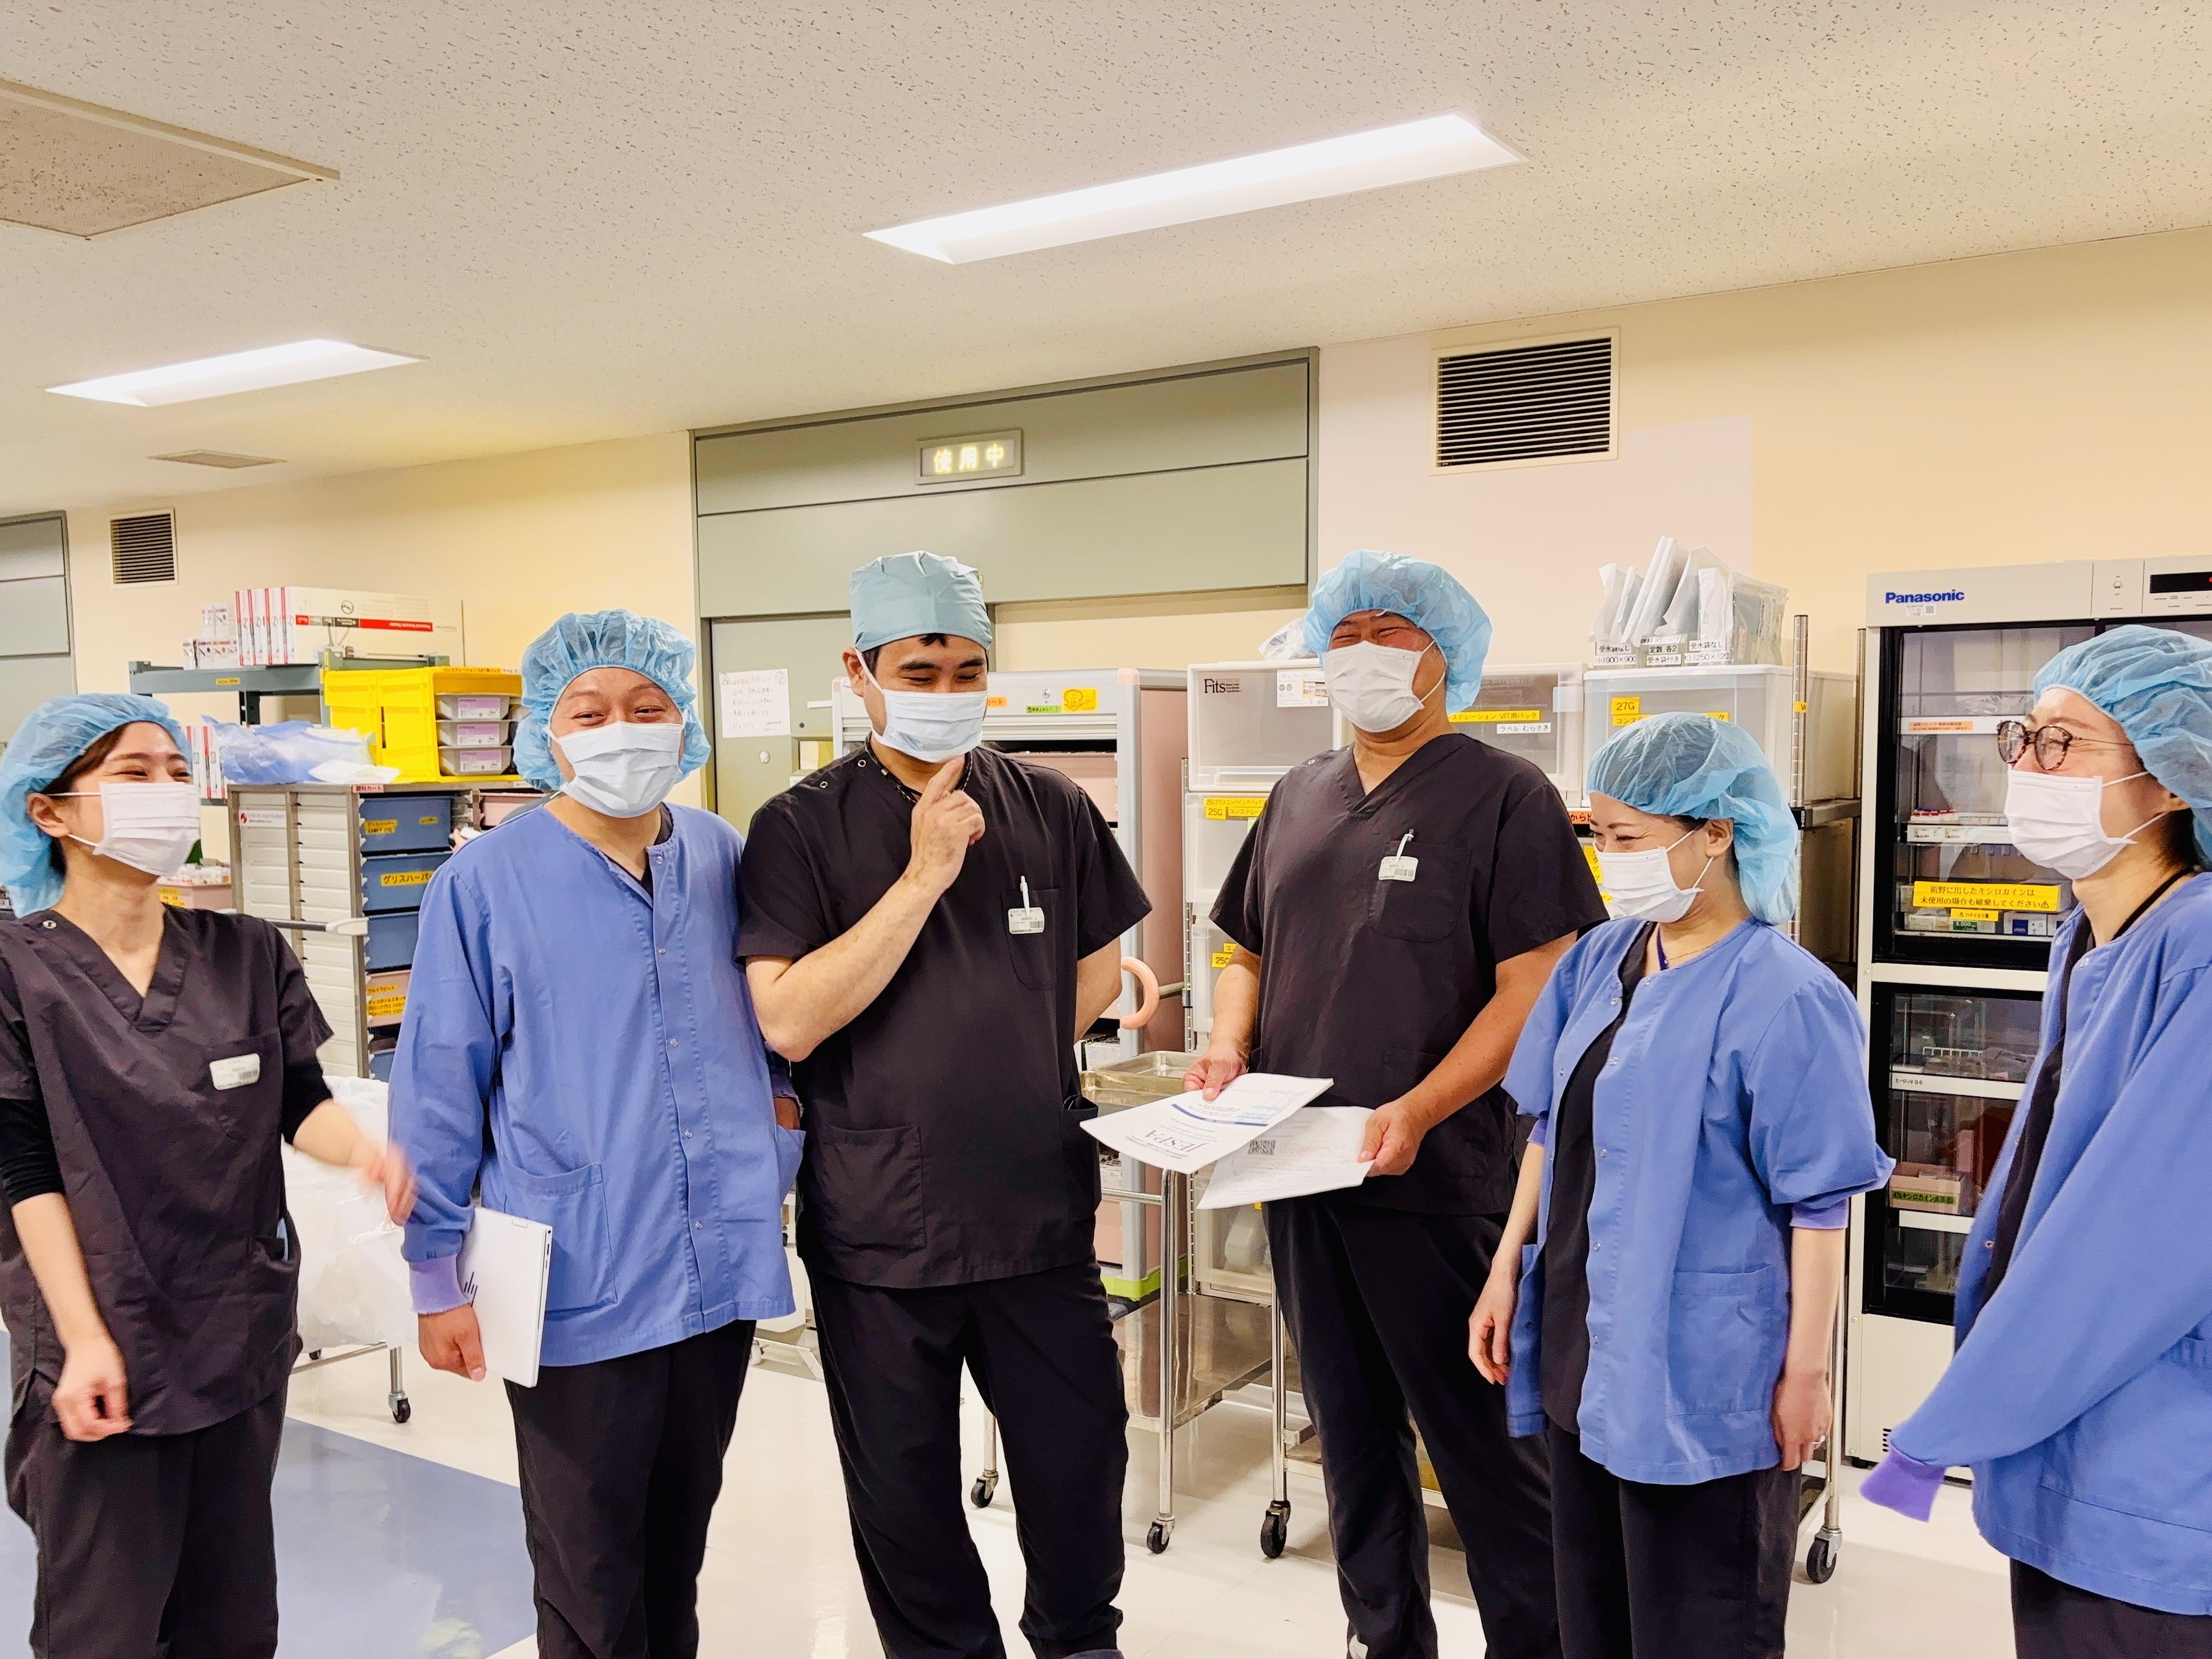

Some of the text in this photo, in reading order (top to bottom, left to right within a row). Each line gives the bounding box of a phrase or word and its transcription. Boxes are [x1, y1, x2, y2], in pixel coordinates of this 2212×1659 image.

[933, 444, 1004, 474] 使用中
[1885, 589, 1965, 604] Panasonic
[1204, 679, 1225, 693] Fits
[1616, 701, 1634, 710] 27G
[1523, 724, 1549, 732] むらさき
[1208, 808, 1222, 816] 25G
[1930, 885, 2035, 896] 術野に出したキシロカインは
[1921, 896, 2041, 908] 未使用の場合も破棄してください
[1145, 1129, 1209, 1152] JESPA
